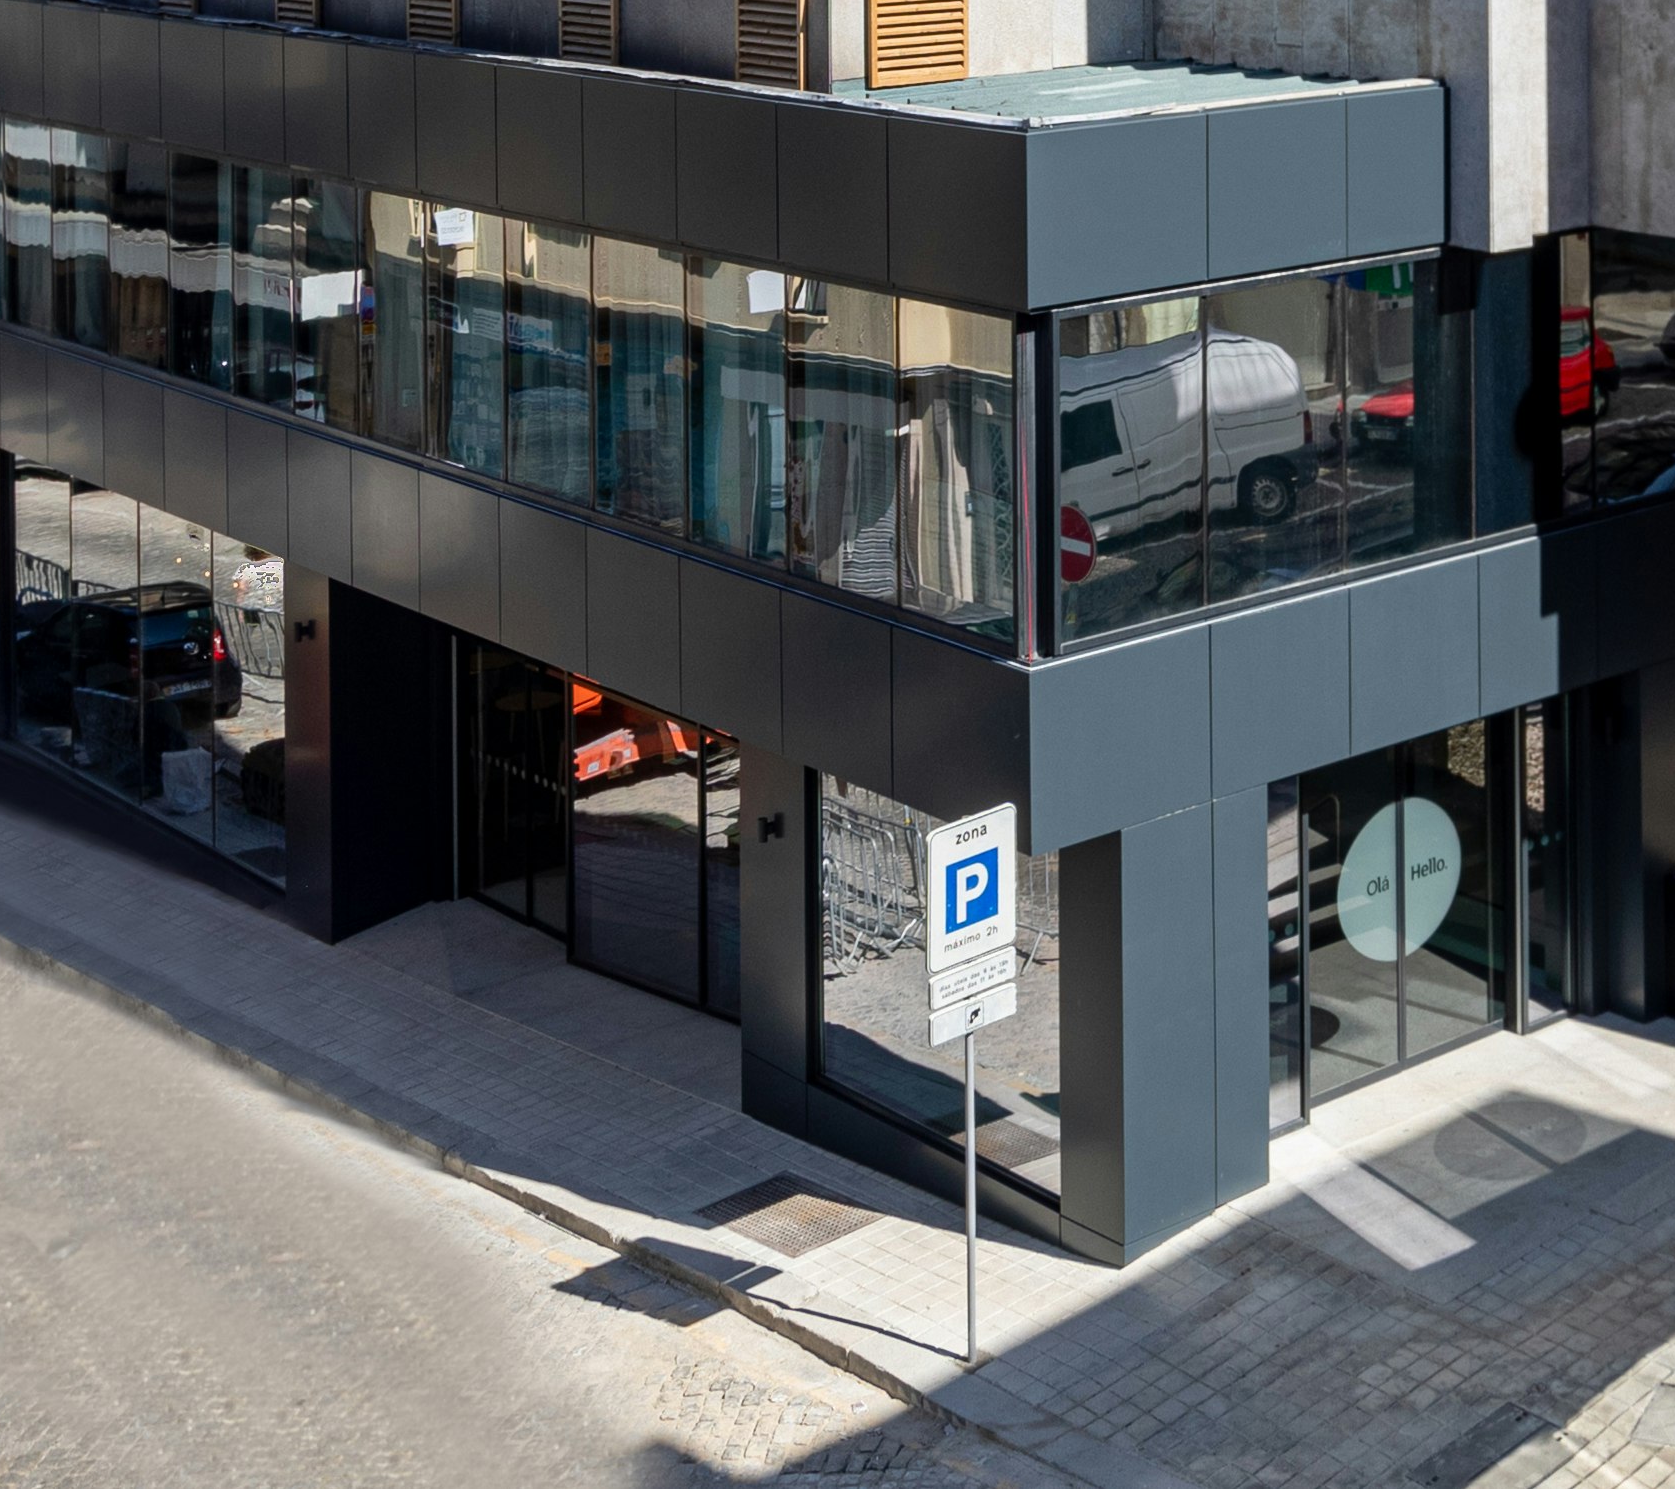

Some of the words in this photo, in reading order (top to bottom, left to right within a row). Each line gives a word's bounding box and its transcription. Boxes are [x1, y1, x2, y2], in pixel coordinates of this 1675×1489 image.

[955, 824, 988, 845] zona
[1366, 875, 1390, 896] Olá
[1410, 856, 1448, 881] Hello.
[956, 861, 989, 925] P
[944, 932, 981, 953] máximo
[986, 926, 999, 937] 2h
